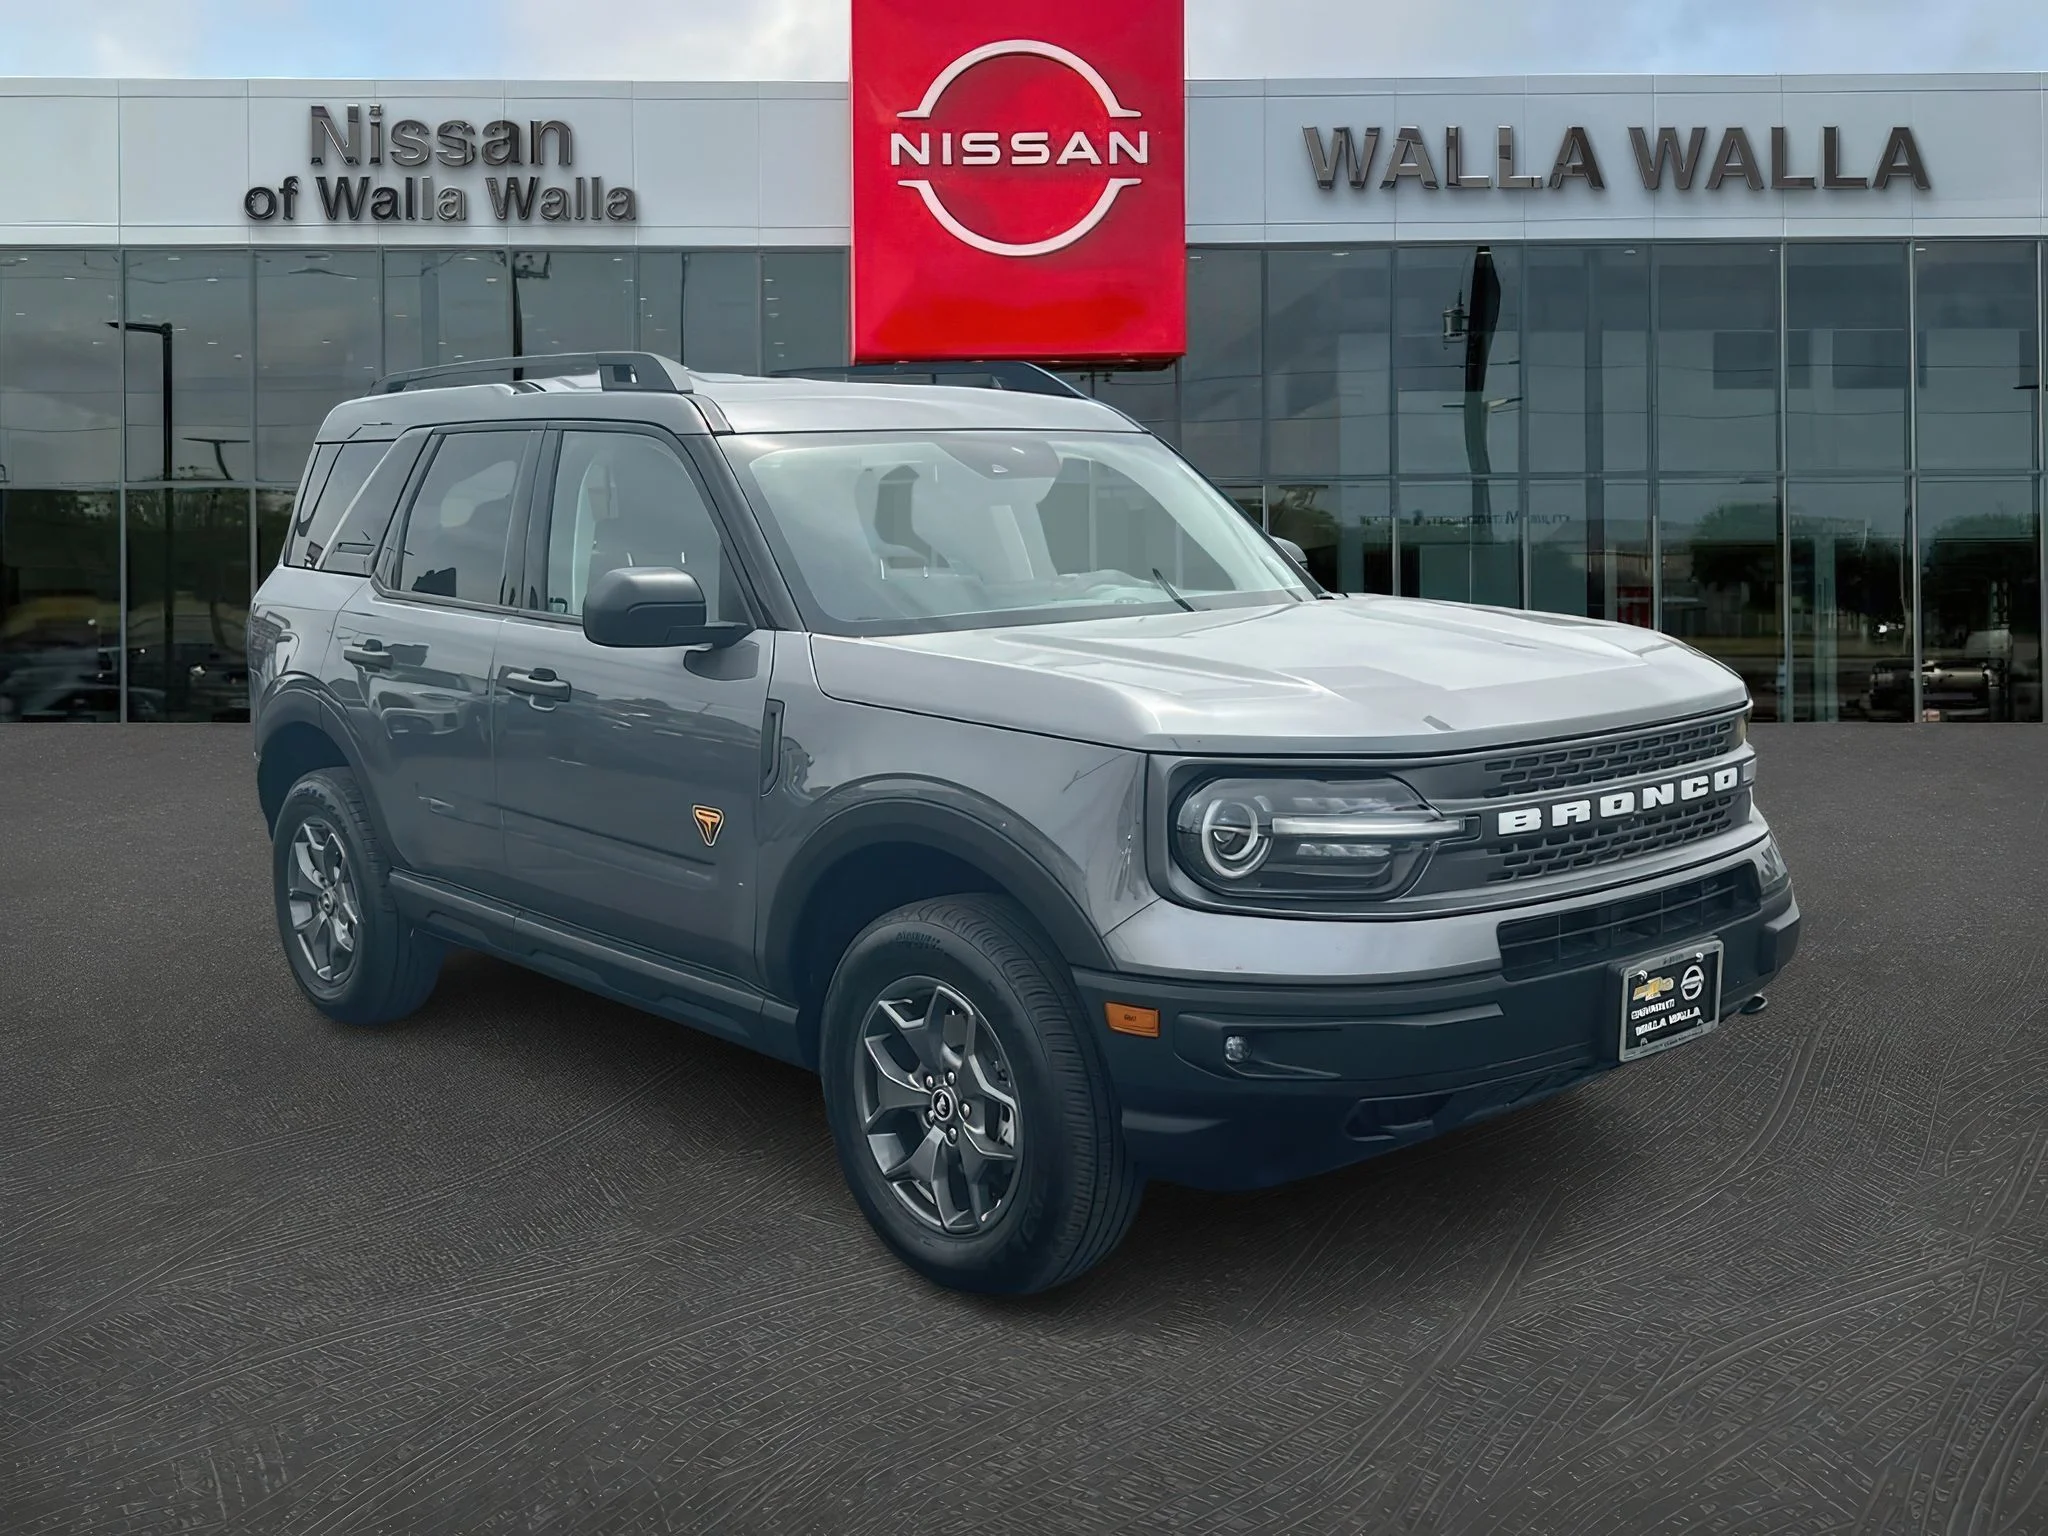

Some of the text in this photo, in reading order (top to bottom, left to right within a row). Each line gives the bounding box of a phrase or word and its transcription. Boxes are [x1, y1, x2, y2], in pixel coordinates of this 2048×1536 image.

[310, 104, 574, 166] Nissan
[890, 131, 1149, 165] NISSAN
[1301, 125, 1931, 190] WALLA WALLA
[244, 176, 637, 221] of Walla Walla
[1498, 767, 1738, 835] BRONCO
